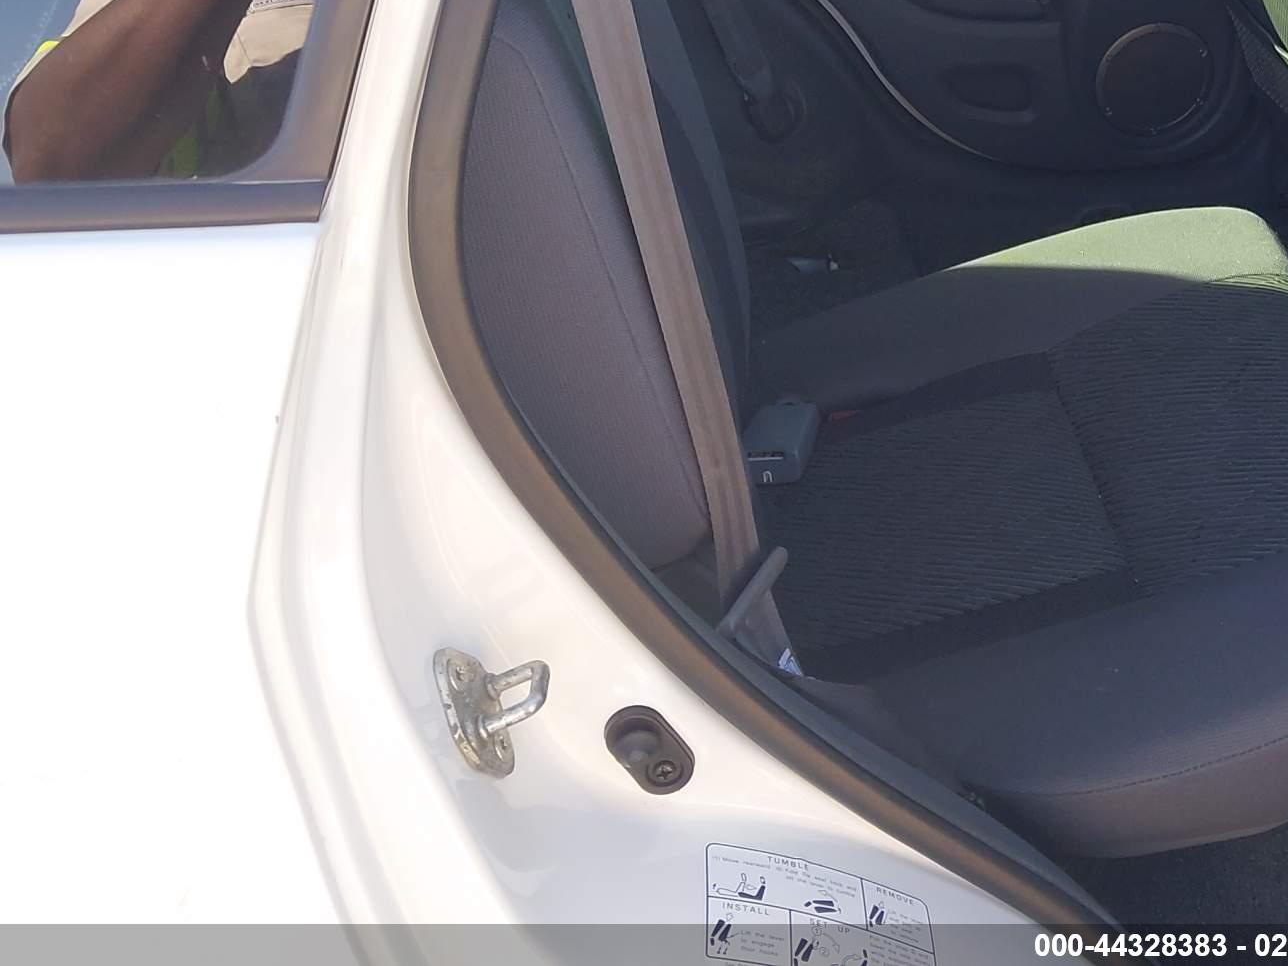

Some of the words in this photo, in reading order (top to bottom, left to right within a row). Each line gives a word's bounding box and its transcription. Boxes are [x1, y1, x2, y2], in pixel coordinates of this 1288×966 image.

[767, 855, 810, 871] TUMBLE
[876, 886, 914, 905] REMOVE
[722, 902, 770, 916] INSTALL
[809, 918, 828, 928] SET
[837, 925, 850, 934] UP
